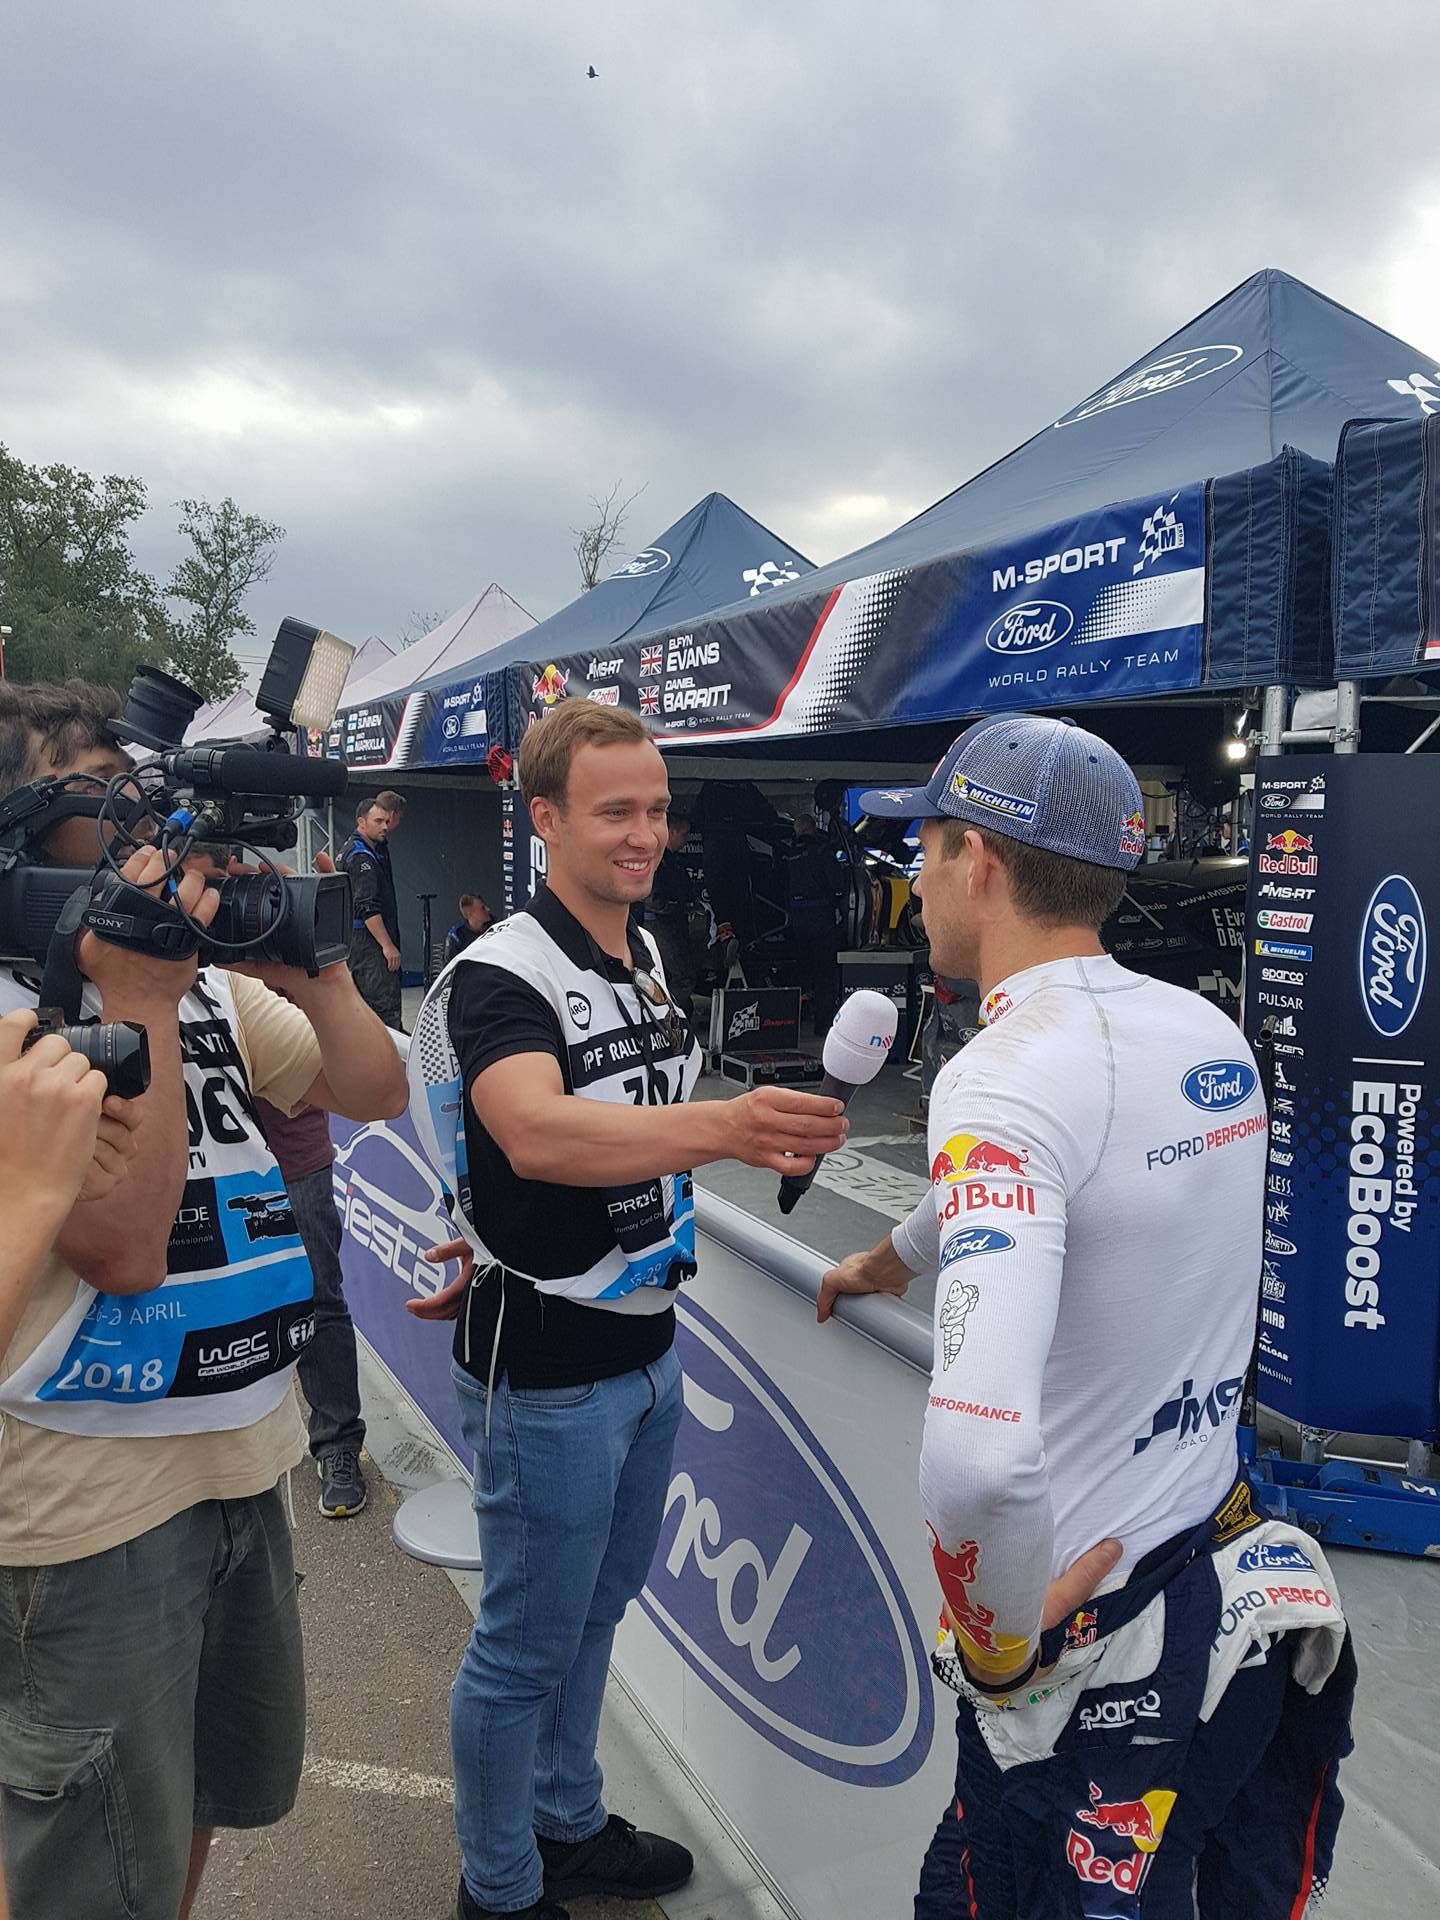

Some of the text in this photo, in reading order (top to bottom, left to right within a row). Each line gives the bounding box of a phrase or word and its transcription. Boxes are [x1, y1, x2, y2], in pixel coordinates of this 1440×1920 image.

[992, 537, 1126, 592] M-SPORT
[997, 608, 1056, 649] Ford
[669, 634, 693, 650] ELFYN
[666, 642, 720, 673] EVANS
[989, 648, 1179, 688] WORLD RALLY TEAM
[665, 677, 695, 692] DANIEL
[663, 684, 732, 713] BARRITT
[1262, 781, 1307, 790] M-SPORT
[970, 787, 1035, 816] MICHELIN
[1259, 854, 1318, 876] Red Bull
[88, 915, 125, 929] SONY
[1211, 908, 1224, 927] E
[1269, 913, 1309, 929] Castrol
[1216, 928, 1228, 947] D
[1270, 947, 1308, 956] MICHELIN
[1369, 901, 1421, 1009] Ford
[1262, 968, 1305, 985] sparco
[997, 998, 1014, 1016] Bull
[1258, 992, 1304, 1011] PULSAR
[1198, 1068, 1244, 1104] Ford
[1271, 1121, 1291, 1139] GK
[1146, 1136, 1204, 1171] FORD
[1389, 1083, 1422, 1233] Powered by
[966, 1183, 1036, 1216] Bull
[1344, 1080, 1397, 1331] EcoBoost
[942, 1231, 992, 1266] Ford
[1265, 1237, 1291, 1252] ANETTI
[129, 1301, 187, 1324] APRIL
[1262, 1307, 1286, 1330] HIAB
[198, 1331, 269, 1365] WRC
[55, 1358, 164, 1393] 2018
[217, 1361, 245, 1373] WORLD
[1257, 1362, 1293, 1385] RMASHINE
[1066, 1828, 1147, 1895] Red
